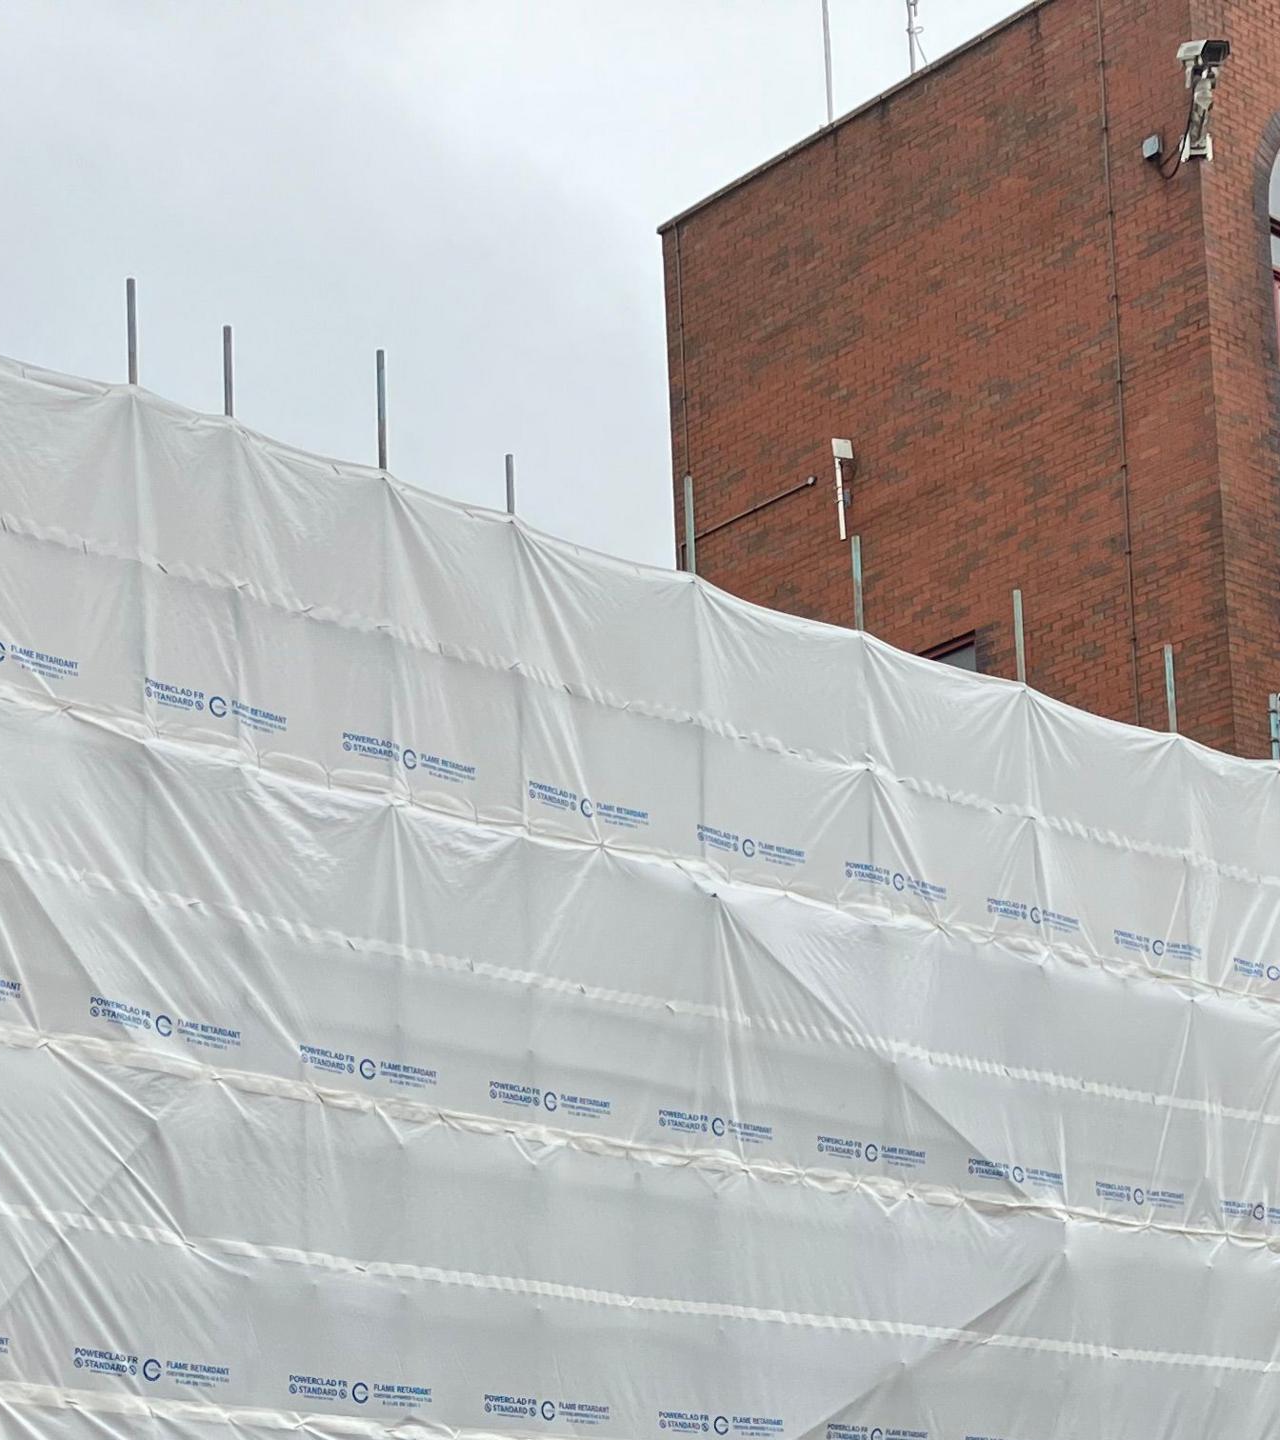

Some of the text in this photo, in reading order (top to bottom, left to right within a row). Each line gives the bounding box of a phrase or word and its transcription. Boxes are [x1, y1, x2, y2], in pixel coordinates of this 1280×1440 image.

[10, 644, 78, 669] FLAME RETARDANT
[145, 677, 204, 699] POWERCLAD FR
[153, 691, 193, 707] STANDARD
[251, 706, 287, 724] RETARDANT
[342, 732, 392, 749] POWERCLAD
[353, 745, 393, 758] STANDARD
[420, 753, 475, 774] FLAME RETARDANT
[529, 781, 577, 801] POWERCLAD FR
[537, 792, 569, 807] STANDARD
[596, 802, 649, 819] FLAME RETARDANT
[697, 824, 731, 840] POWERCLAD
[705, 833, 732, 849] STANDARD
[758, 842, 774, 851] FLAME
[845, 862, 890, 876] POWERCLAD FR
[854, 870, 884, 882] STANDARD
[90, 997, 150, 1018] POWERCLAD FR
[101, 1009, 141, 1025] STANDARD
[178, 1019, 241, 1039] FLAME RETARDANT
[300, 1045, 344, 1061] POWERCLAD
[309, 1056, 345, 1071] STANDARD
[380, 1061, 436, 1078] FLAME RETARDANT
[490, 1081, 531, 1093] POWERCLAD
[498, 1091, 532, 1104] STANDARD
[561, 1094, 610, 1108] FLAME RETARDANT
[659, 1110, 698, 1121] POWERCLAD
[667, 1120, 700, 1130] STANDARD
[817, 1136, 853, 1147] POWERCLAD
[825, 1146, 854, 1156] STANDARD
[968, 1159, 1002, 1167] POWERCLAD
[975, 1167, 1003, 1176] STANDARD
[75, 1348, 138, 1364] POWERCLAD FR
[85, 1359, 127, 1373] STANDARD
[166, 1361, 229, 1375] FLAME RETARDANT
[289, 1375, 336, 1386] POWERCLAD
[299, 1386, 337, 1397] STANDARD
[374, 1384, 432, 1395] FLAME RETARDANT
[485, 1394, 527, 1405] POWERCLAD
[493, 1404, 527, 1414] STANDARD
[559, 1402, 609, 1413] FLAME RETARDANT
[659, 1411, 699, 1420] POWERCLAD
[753, 1418, 782, 1426] RETARDANT
[668, 1421, 700, 1429] STANDARD
[832, 1433, 860, 1440] STANDARD
